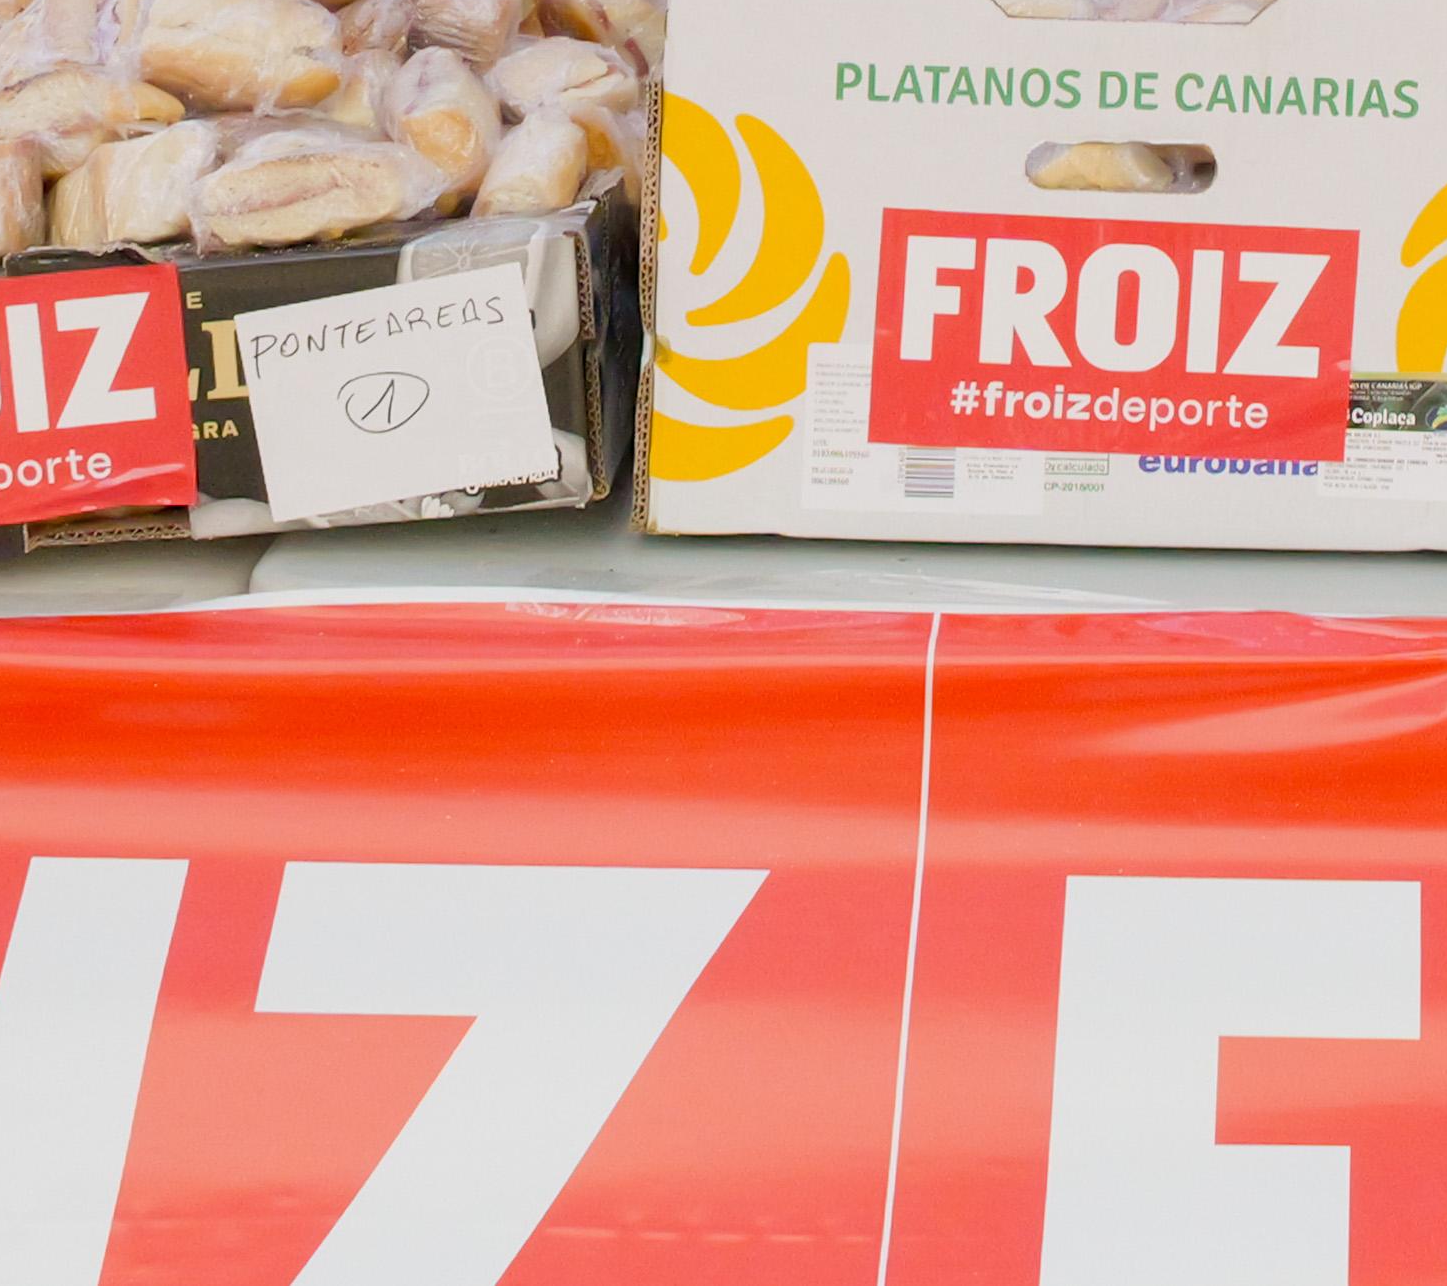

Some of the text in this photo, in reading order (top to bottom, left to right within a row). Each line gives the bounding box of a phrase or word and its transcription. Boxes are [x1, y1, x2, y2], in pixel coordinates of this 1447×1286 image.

[834, 61, 1421, 119] PLATANOS DE CANARIAS
[899, 234, 1332, 379] FROIZ
[950, 380, 1270, 433] #froizdeporte
[1351, 407, 1416, 428] Coplaca
[1138, 454, 1319, 476] eurobana
